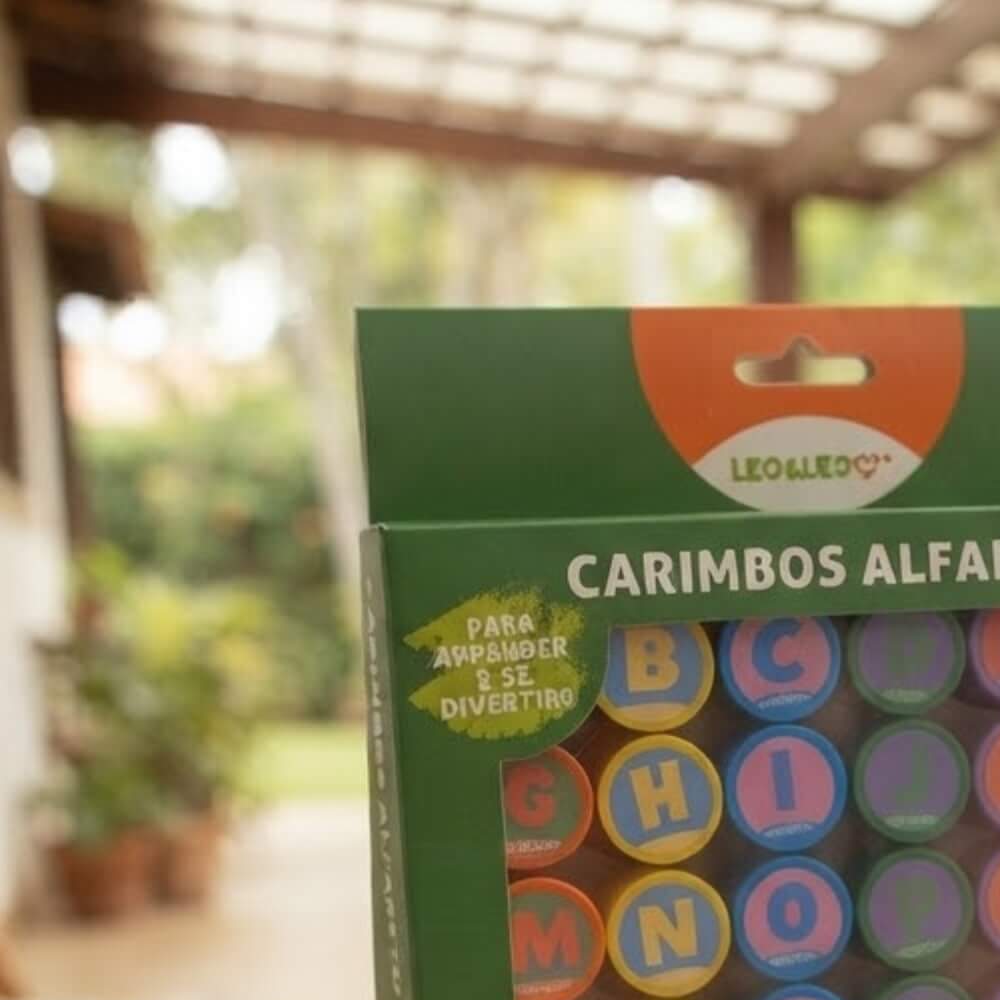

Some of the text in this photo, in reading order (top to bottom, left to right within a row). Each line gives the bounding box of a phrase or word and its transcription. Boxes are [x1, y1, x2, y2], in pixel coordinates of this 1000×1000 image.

[566, 545, 846, 600] CARIMBOS
[466, 613, 535, 641] PARA
[624, 626, 680, 694] B
[751, 616, 807, 684] C
[501, 664, 535, 689] SE
[503, 764, 556, 829] G
[629, 759, 689, 832] H
[768, 748, 797, 812] I
[512, 907, 580, 974] M
[638, 897, 699, 967] N
